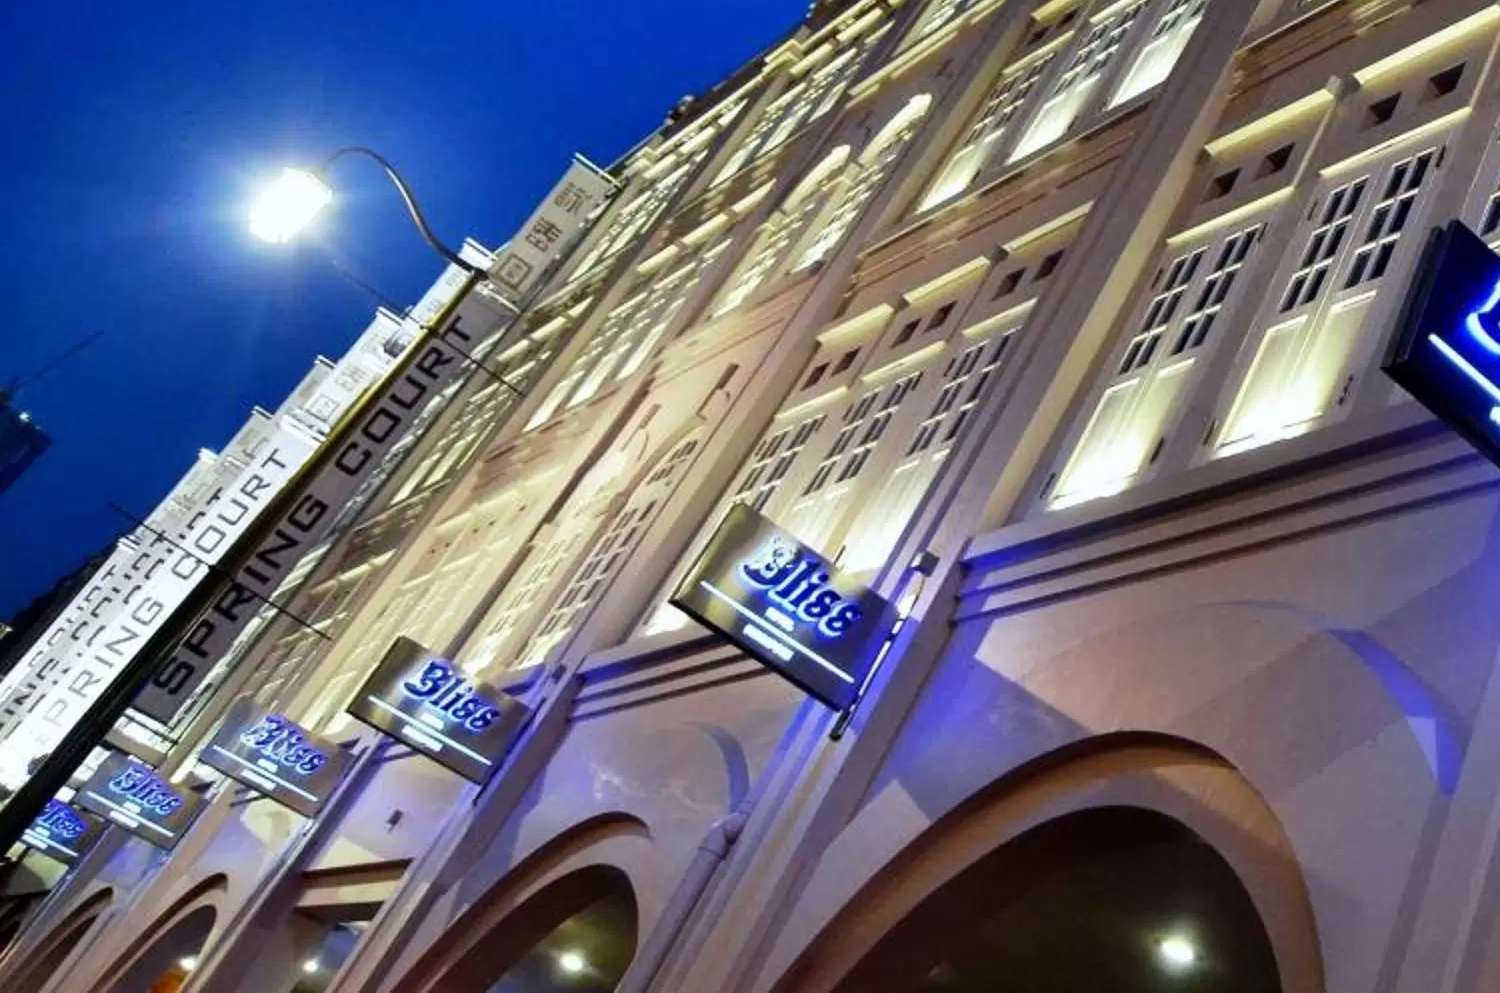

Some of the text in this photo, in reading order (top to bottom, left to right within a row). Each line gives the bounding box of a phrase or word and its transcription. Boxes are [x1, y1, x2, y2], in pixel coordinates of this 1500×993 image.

[154, 496, 328, 695] SPRING
[335, 315, 471, 475] COURT
[36, 596, 164, 745] PRING
[171, 448, 287, 580] COURT
[737, 536, 863, 637] Bliss
[403, 658, 499, 734] Bliss
[36, 800, 88, 838] liss
